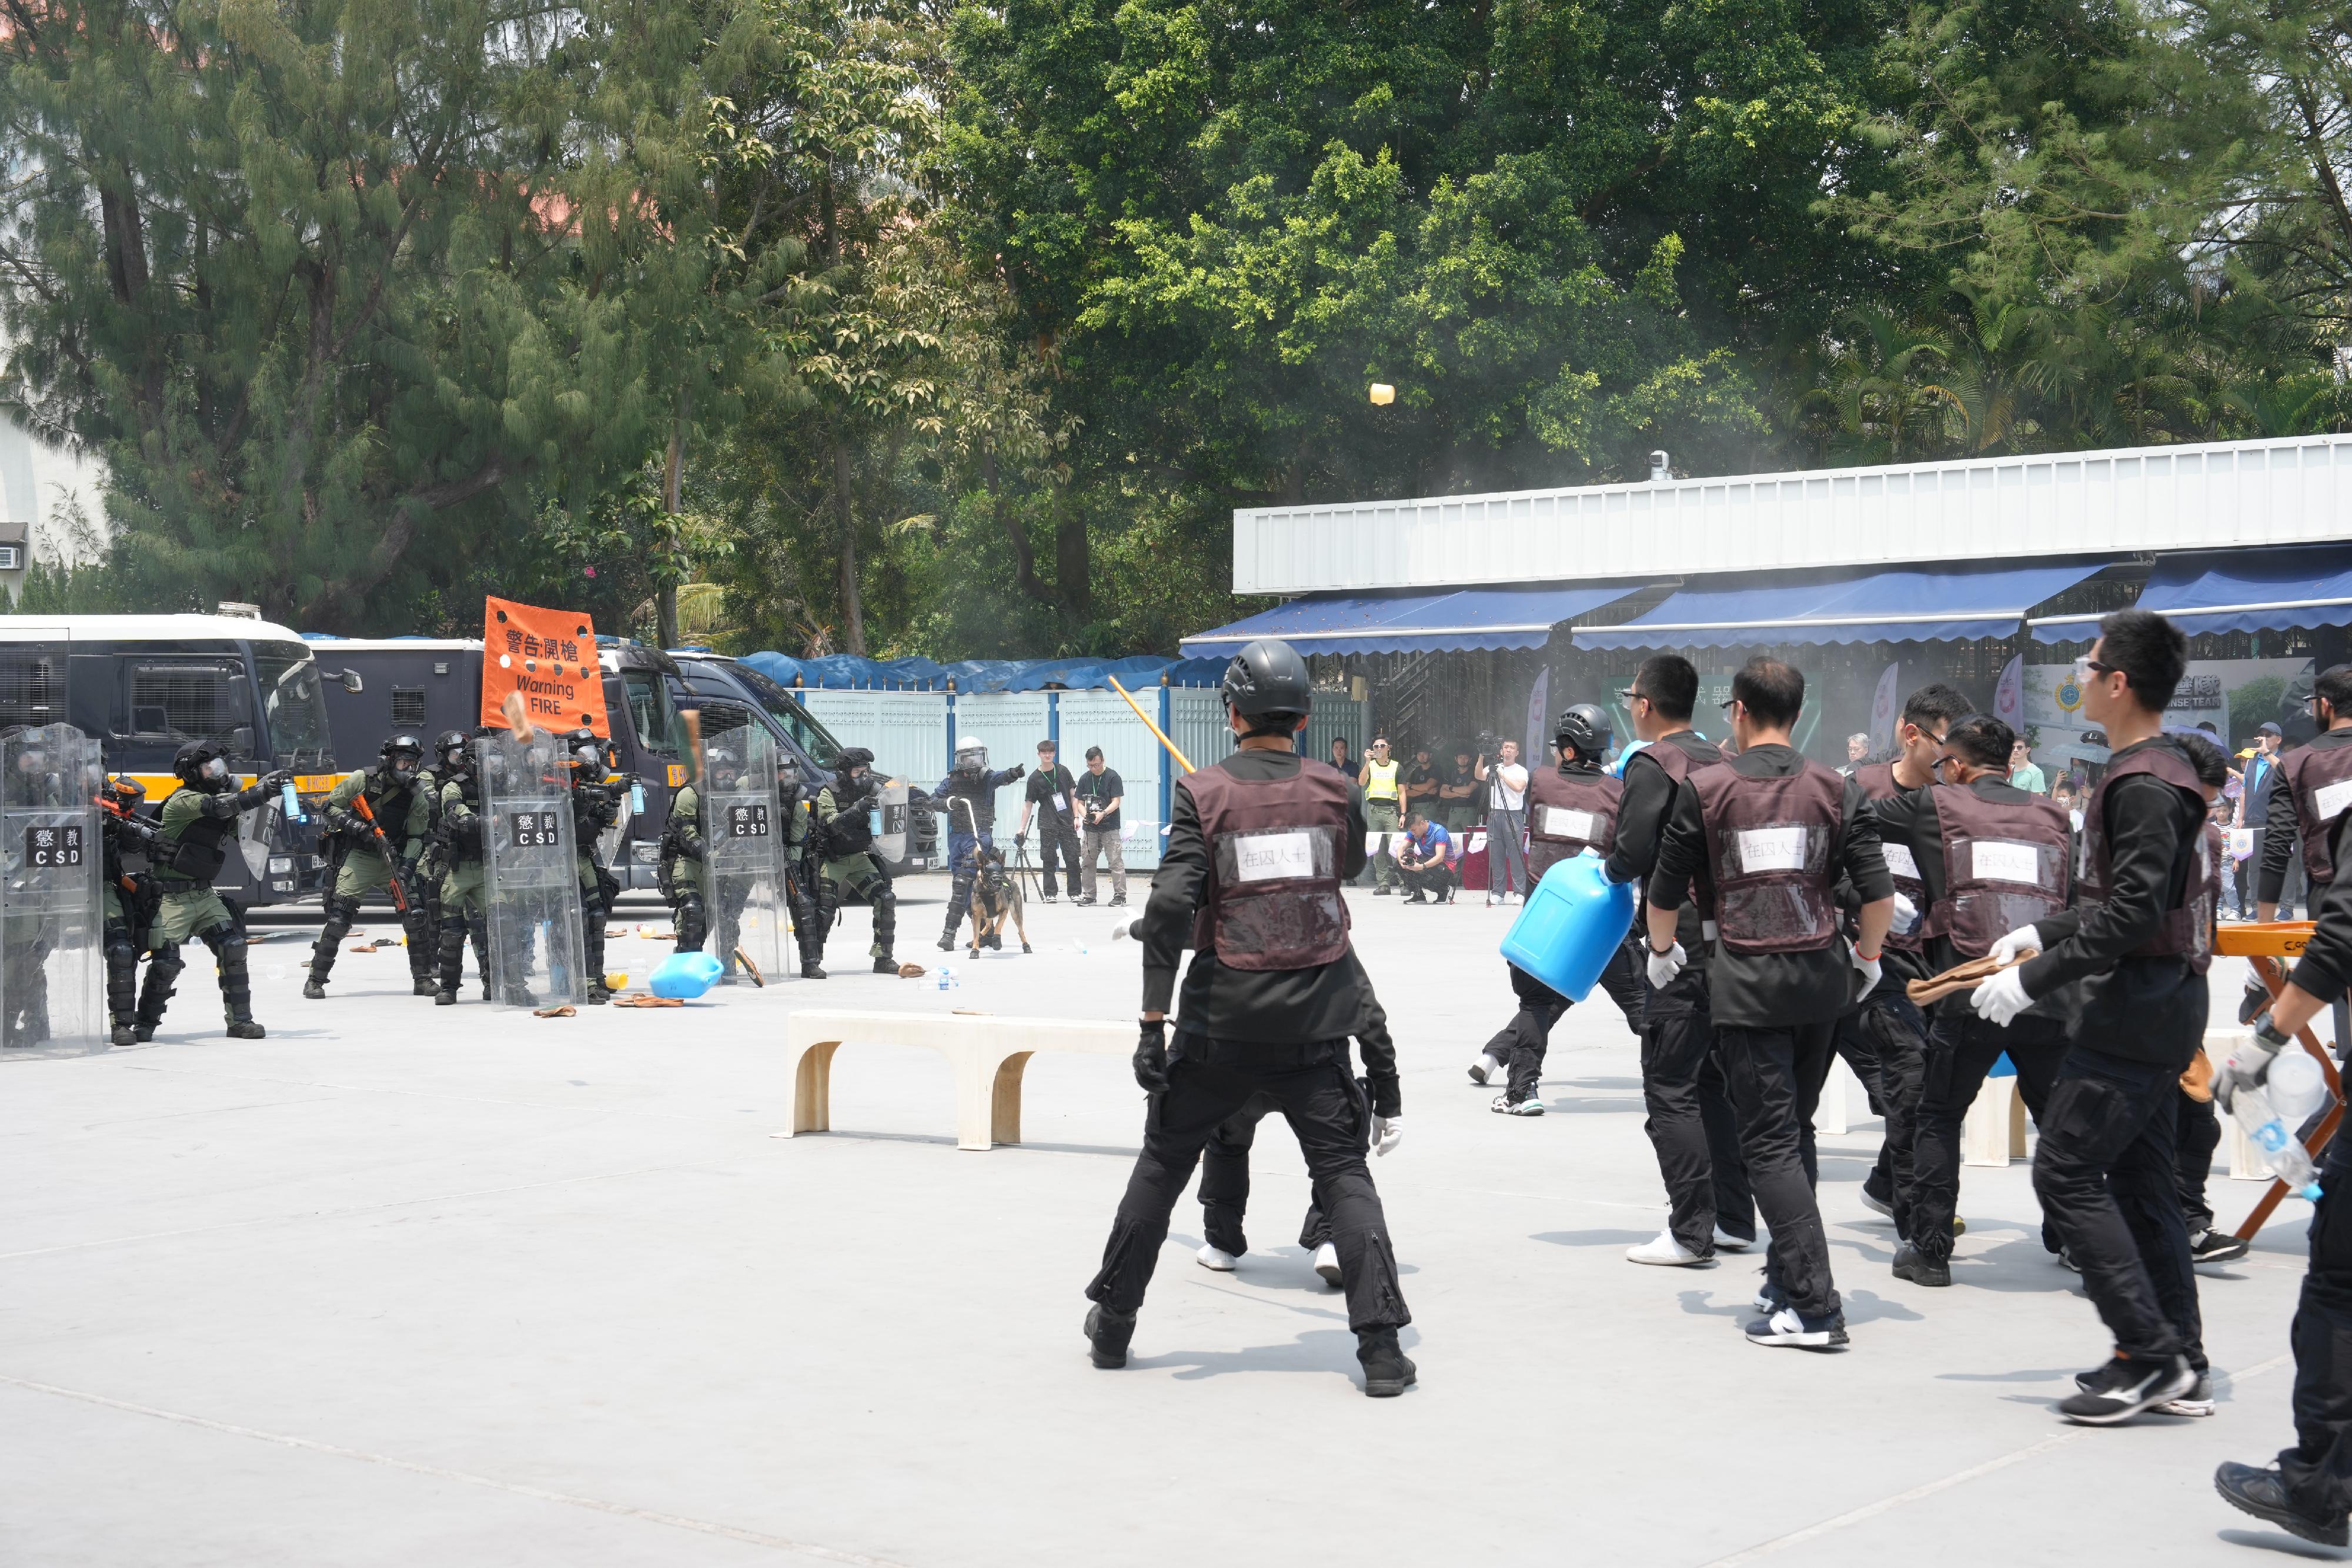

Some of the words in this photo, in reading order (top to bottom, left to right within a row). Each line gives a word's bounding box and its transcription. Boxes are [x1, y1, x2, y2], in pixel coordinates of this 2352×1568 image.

[506, 629, 579, 663] 警告:開槍
[517, 674, 574, 700] Warning
[530, 697, 562, 715] FIRE
[2192, 697, 2220, 707] TEAM
[736, 823, 766, 835] CSD
[893, 820, 905, 833] CSD
[519, 832, 555, 844] CSD
[35, 850, 78, 864] CSD
[1745, 841, 1802, 858] 在囚人士
[1242, 847, 1306, 868] 在囚人士
